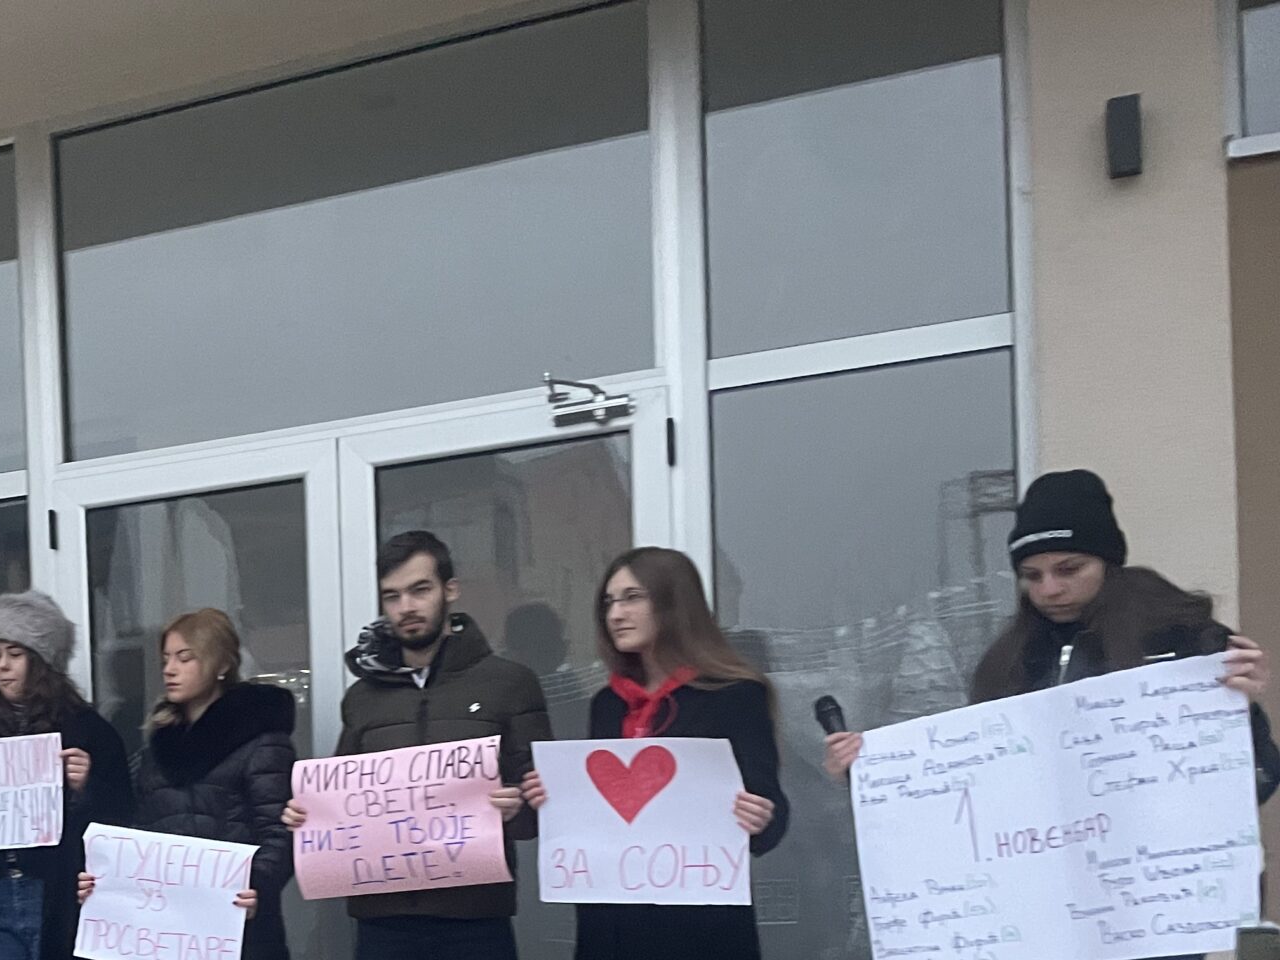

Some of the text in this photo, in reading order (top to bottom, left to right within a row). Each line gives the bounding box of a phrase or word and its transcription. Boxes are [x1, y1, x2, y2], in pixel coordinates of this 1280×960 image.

[300, 738, 500, 793] МИРНО СПАВАЈ
[301, 809, 476, 854] НИЈЕ ТВОЈЕ
[86, 834, 252, 890] СТУДЕНТИ
[352, 841, 465, 886] ДЕТЕ!
[551, 843, 748, 891] ЗА СОЊУ
[136, 887, 167, 911] УЗ
